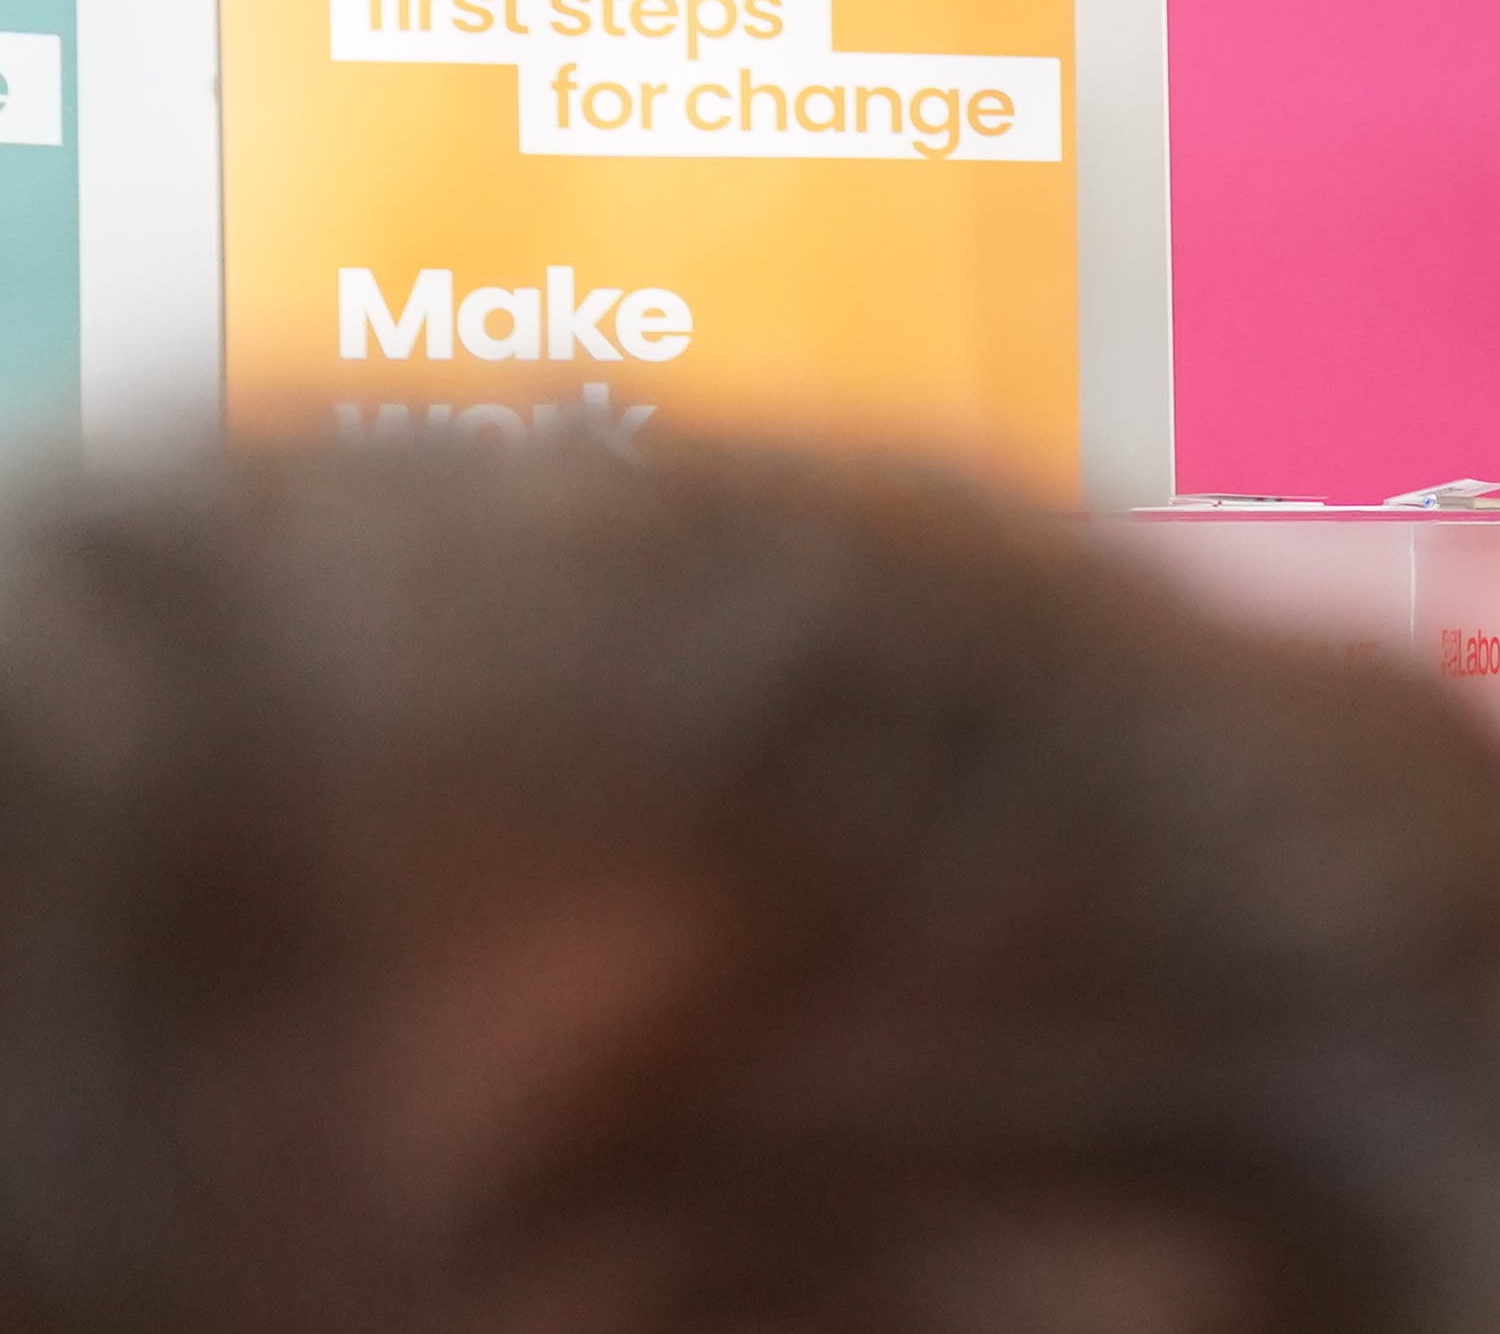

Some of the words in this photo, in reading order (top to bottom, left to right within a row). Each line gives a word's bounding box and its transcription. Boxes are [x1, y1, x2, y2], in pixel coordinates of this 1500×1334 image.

[550, 64, 669, 131] for
[683, 68, 1017, 161] change
[337, 265, 694, 364] Make
